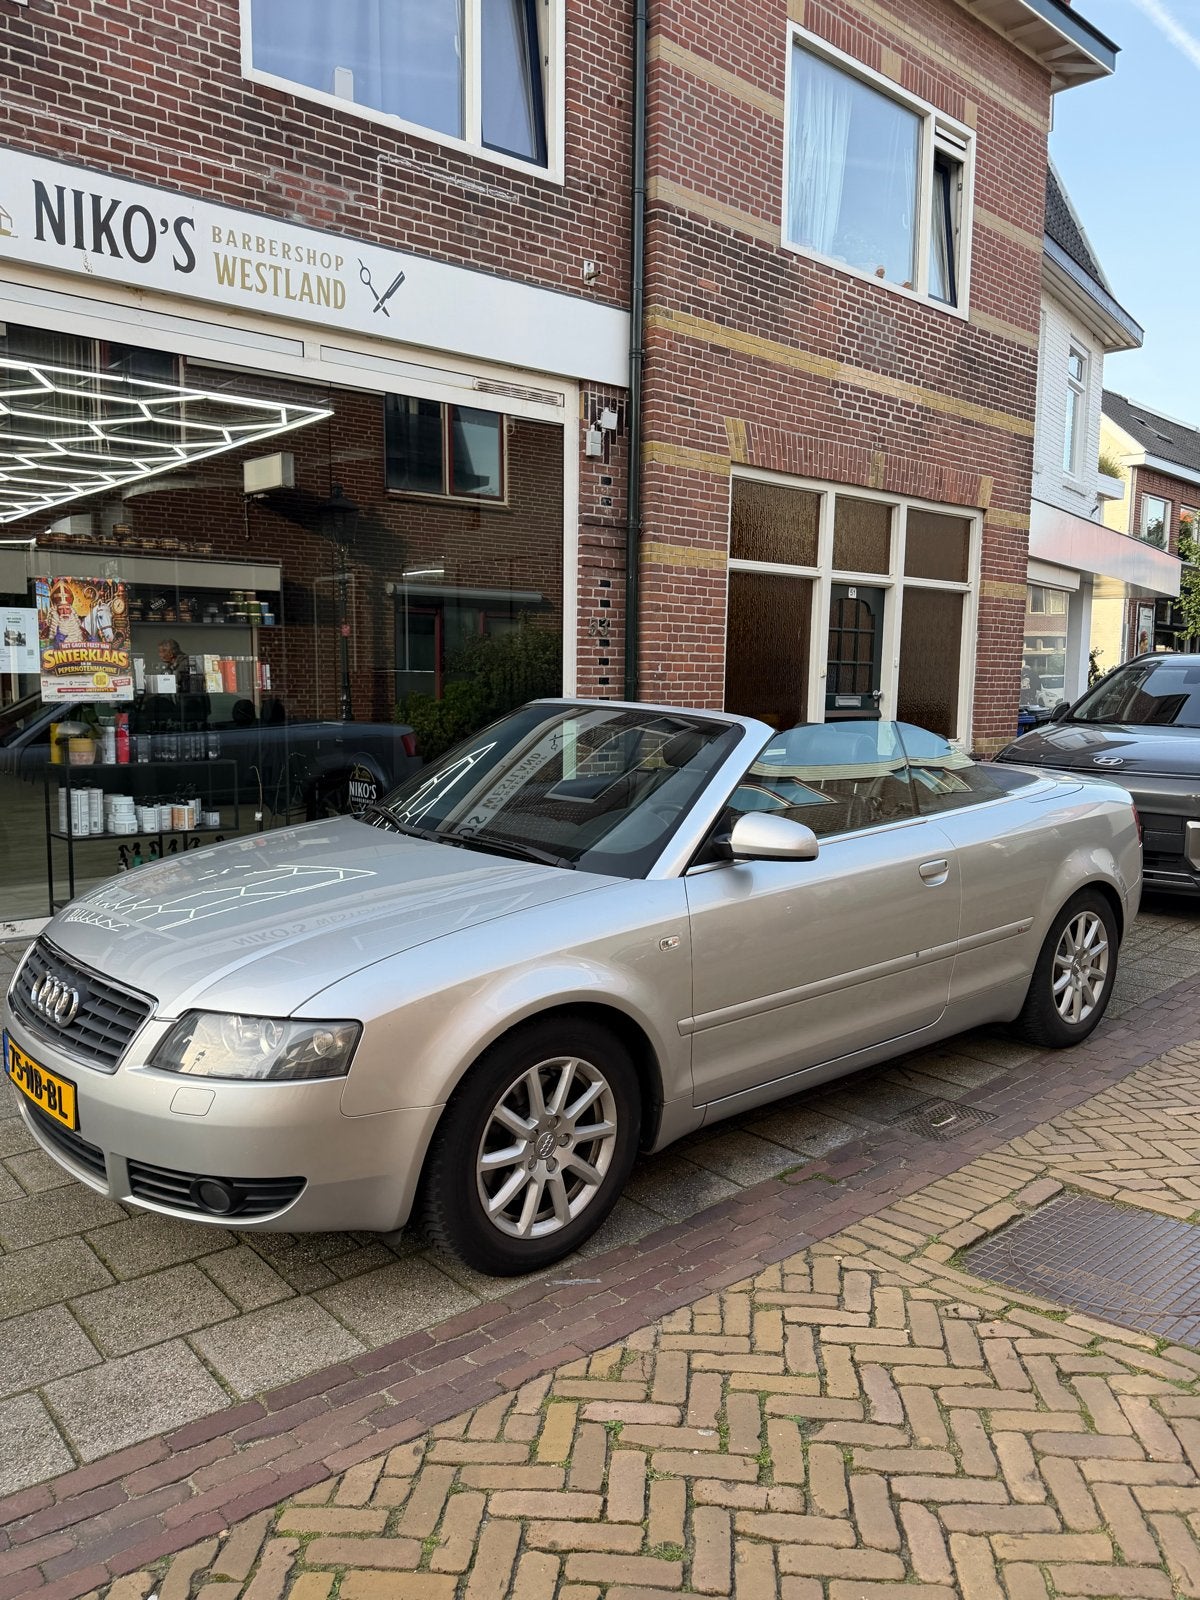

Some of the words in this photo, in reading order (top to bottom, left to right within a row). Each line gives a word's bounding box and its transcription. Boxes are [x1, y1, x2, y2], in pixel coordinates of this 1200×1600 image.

[32, 179, 197, 274] NIKO'S
[211, 225, 345, 272] BARBERSHOP
[213, 251, 347, 311] WESTLAND
[43, 648, 129, 669] SINTERKLAAS
[349, 780, 377, 800] NIKO'S
